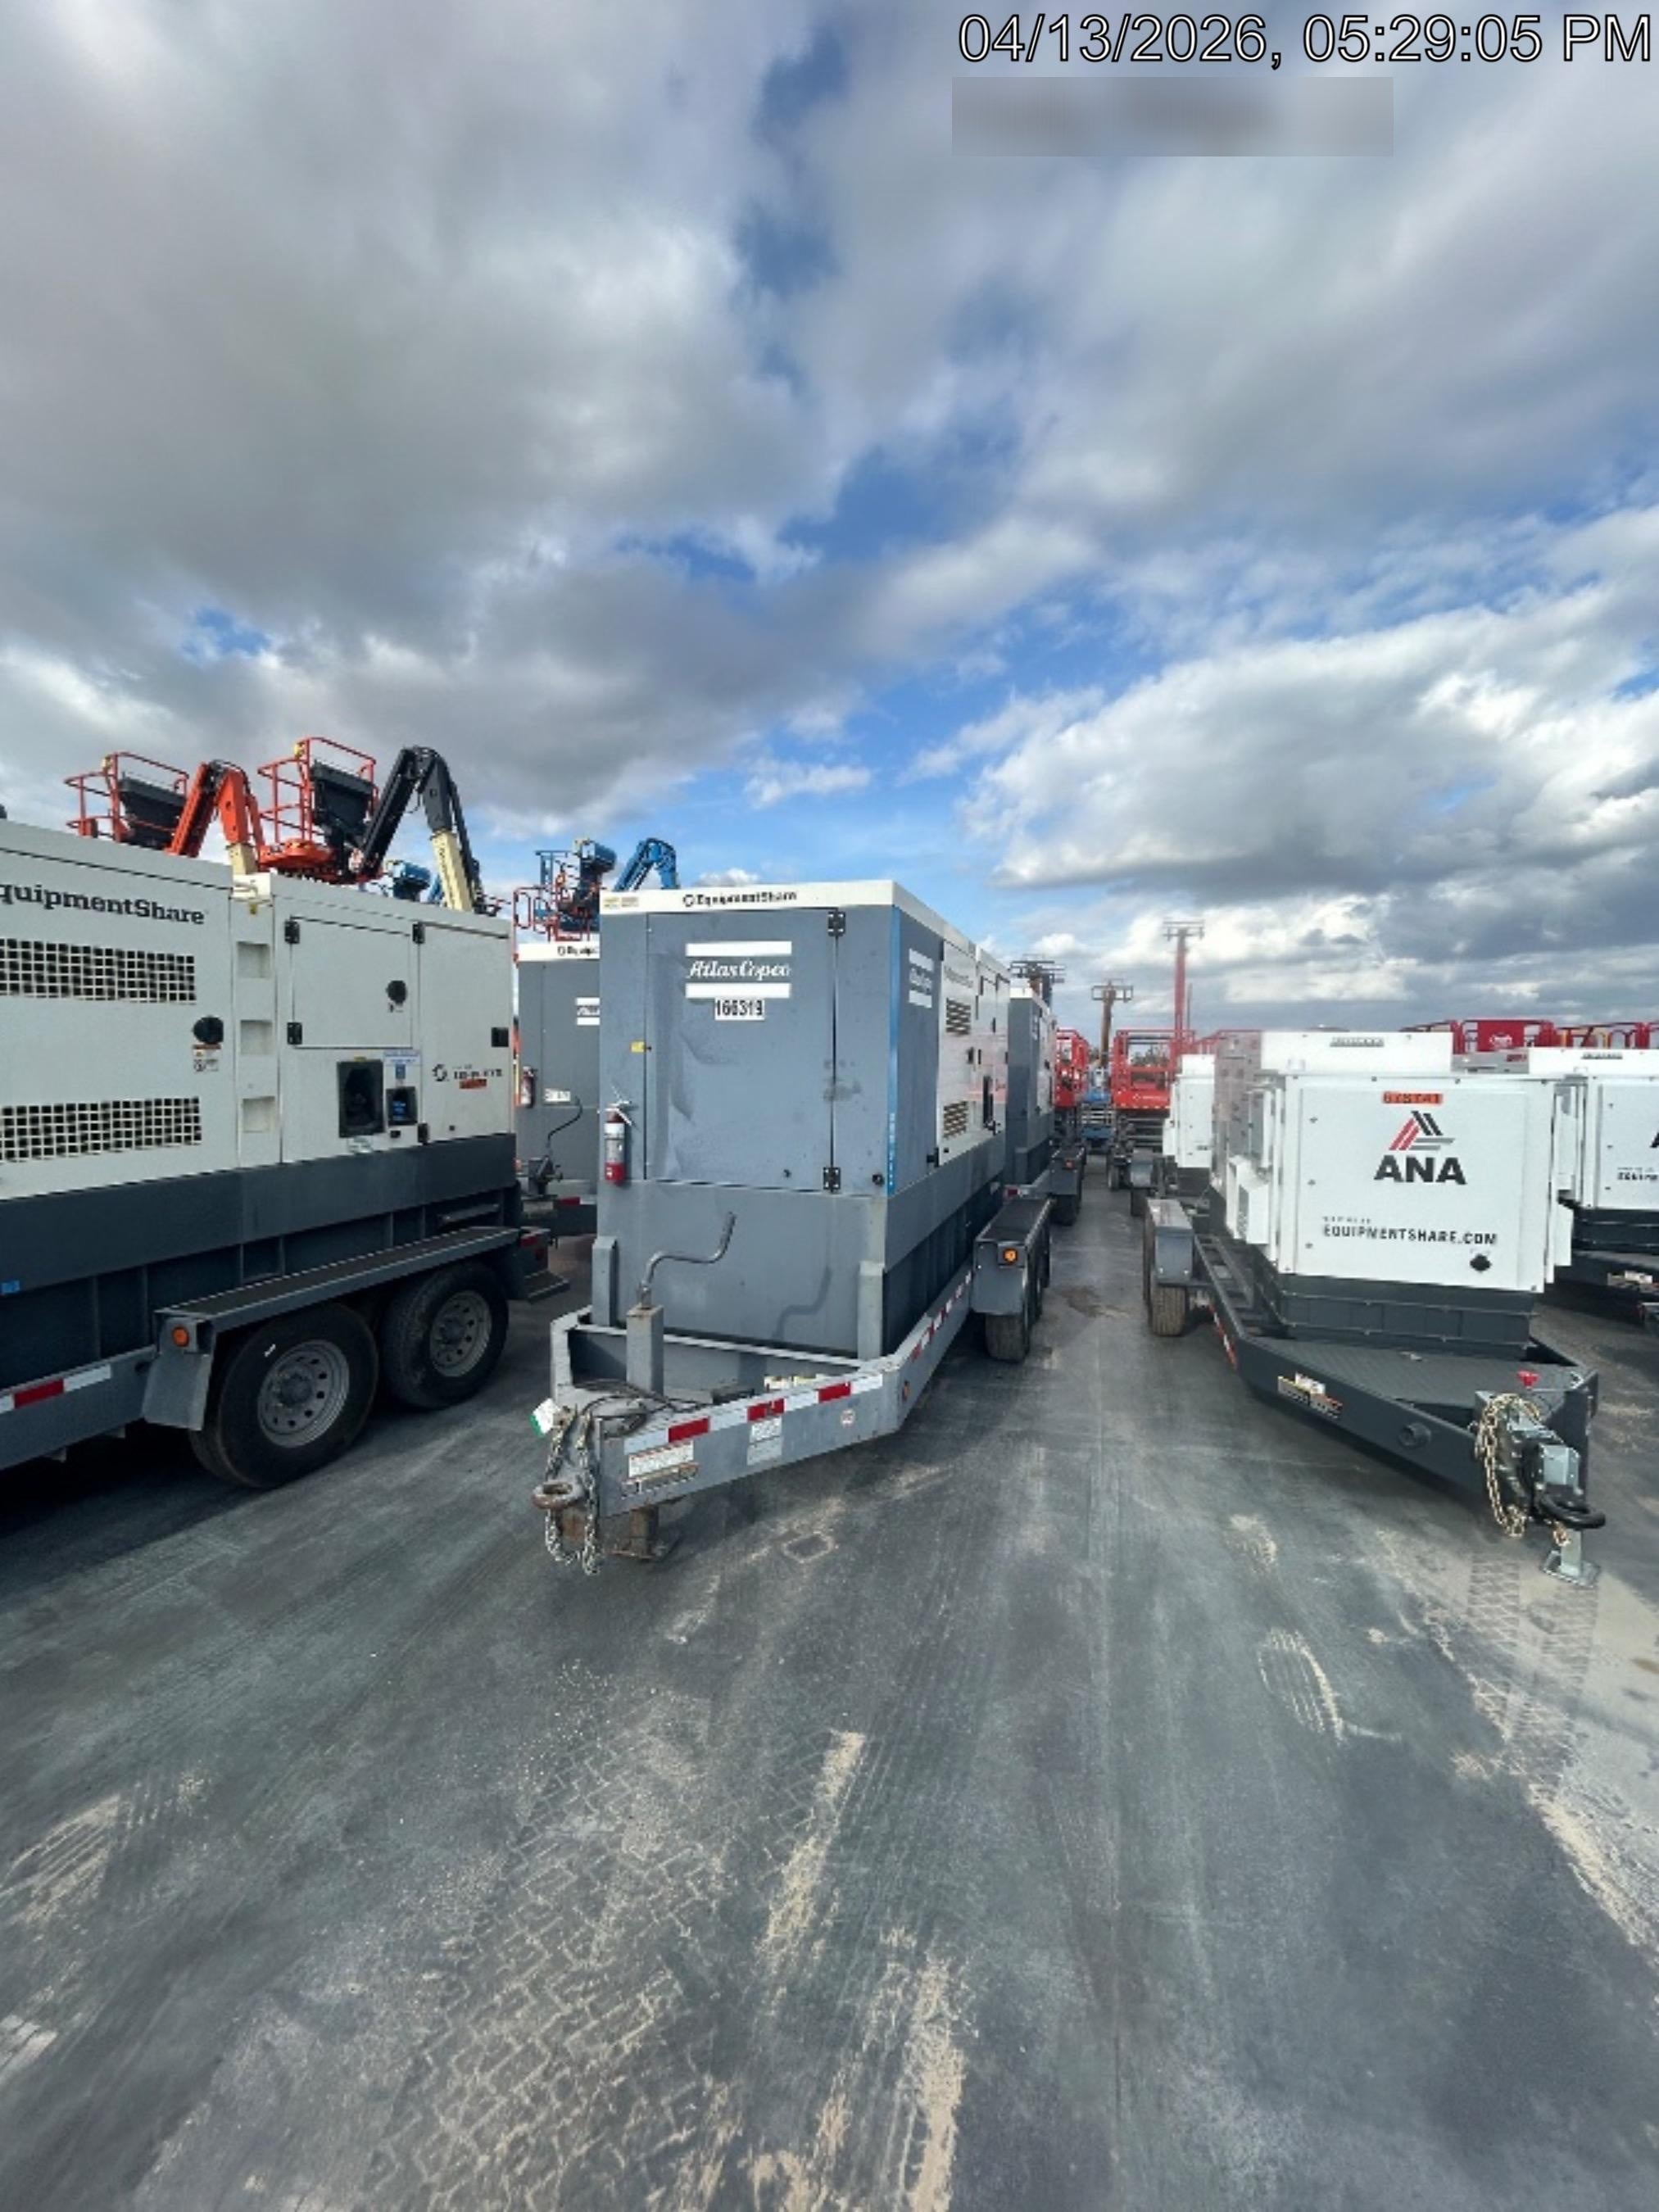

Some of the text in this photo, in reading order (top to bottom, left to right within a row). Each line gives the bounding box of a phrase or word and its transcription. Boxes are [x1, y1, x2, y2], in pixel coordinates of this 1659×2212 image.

[687, 960, 737, 979] Atlas
[1373, 1154, 1467, 1185] ANA
[1323, 1224, 1498, 1244] EQUIPMENTSHARE.COM
